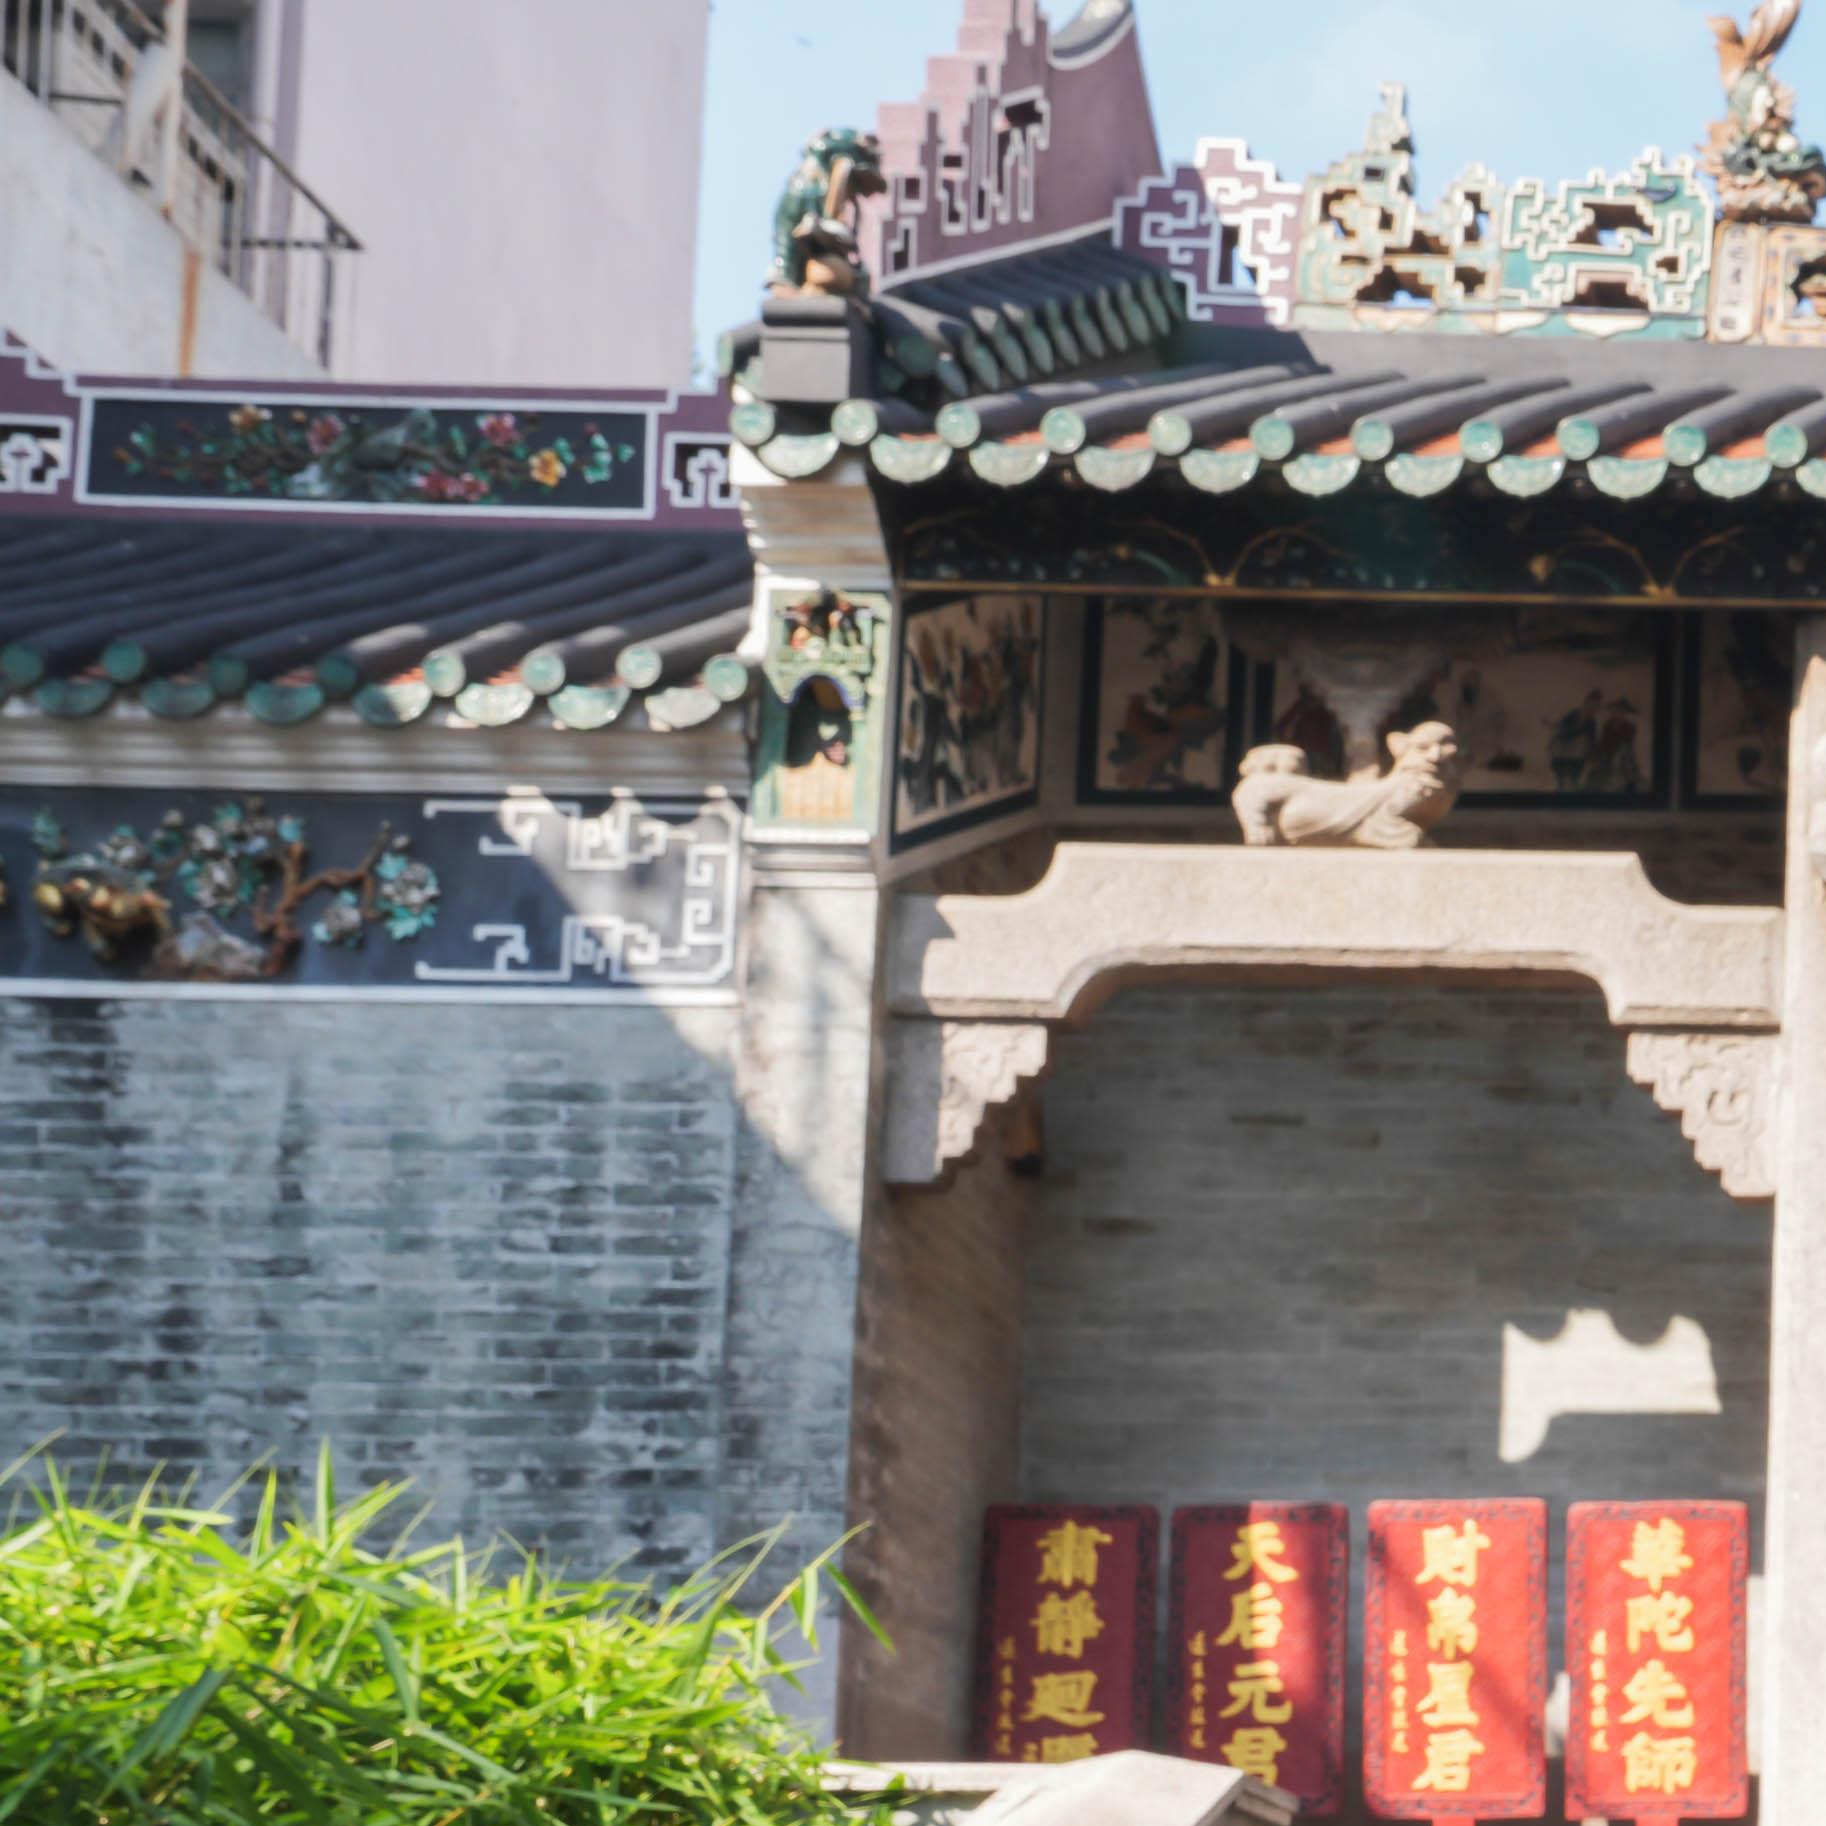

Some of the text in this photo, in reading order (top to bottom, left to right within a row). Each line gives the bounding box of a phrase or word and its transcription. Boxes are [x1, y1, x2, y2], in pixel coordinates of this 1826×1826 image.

[1215, 1520, 1300, 1788] 天后元君
[1411, 1518, 1492, 1792] 財帛星君
[1618, 1517, 1698, 1795] 華陀先師
